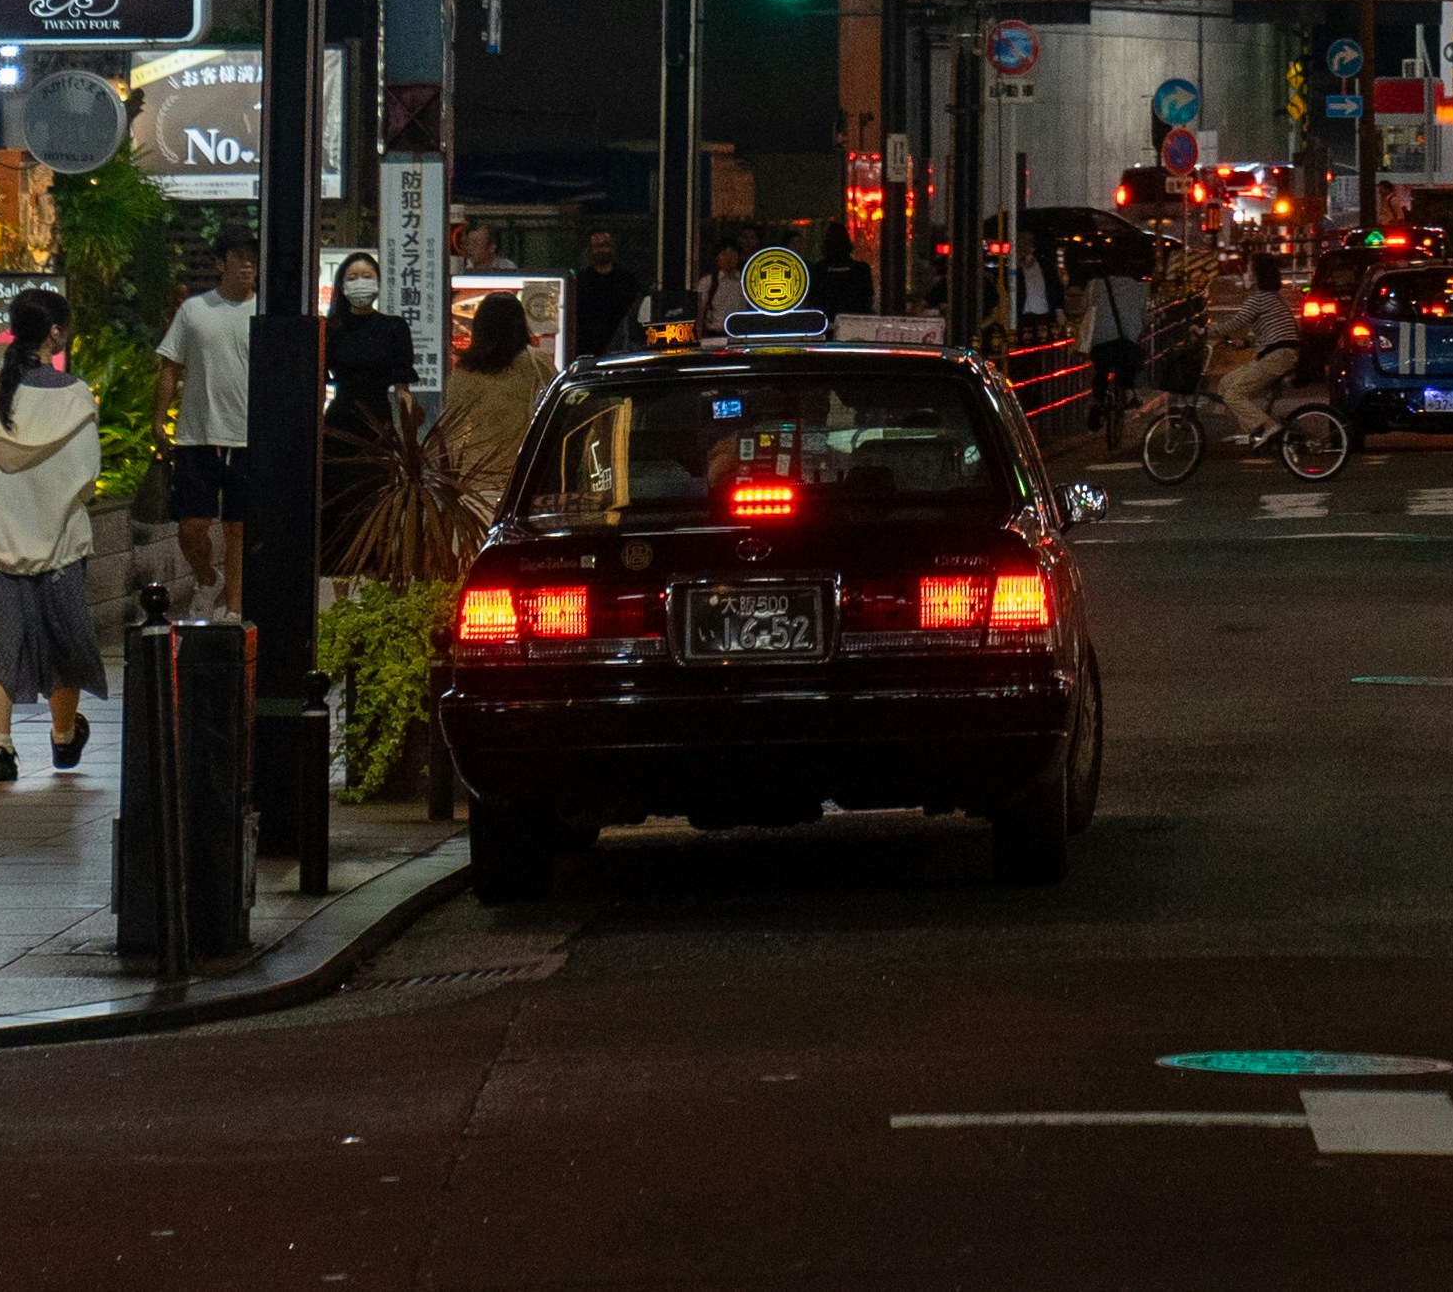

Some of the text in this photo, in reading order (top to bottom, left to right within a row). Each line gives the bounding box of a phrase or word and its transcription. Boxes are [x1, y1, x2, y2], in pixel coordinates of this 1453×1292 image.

[400, 169, 422, 327] 防犯カメラ作動中
[719, 595, 790, 615] 大阪500
[721, 616, 813, 651] 16-52
